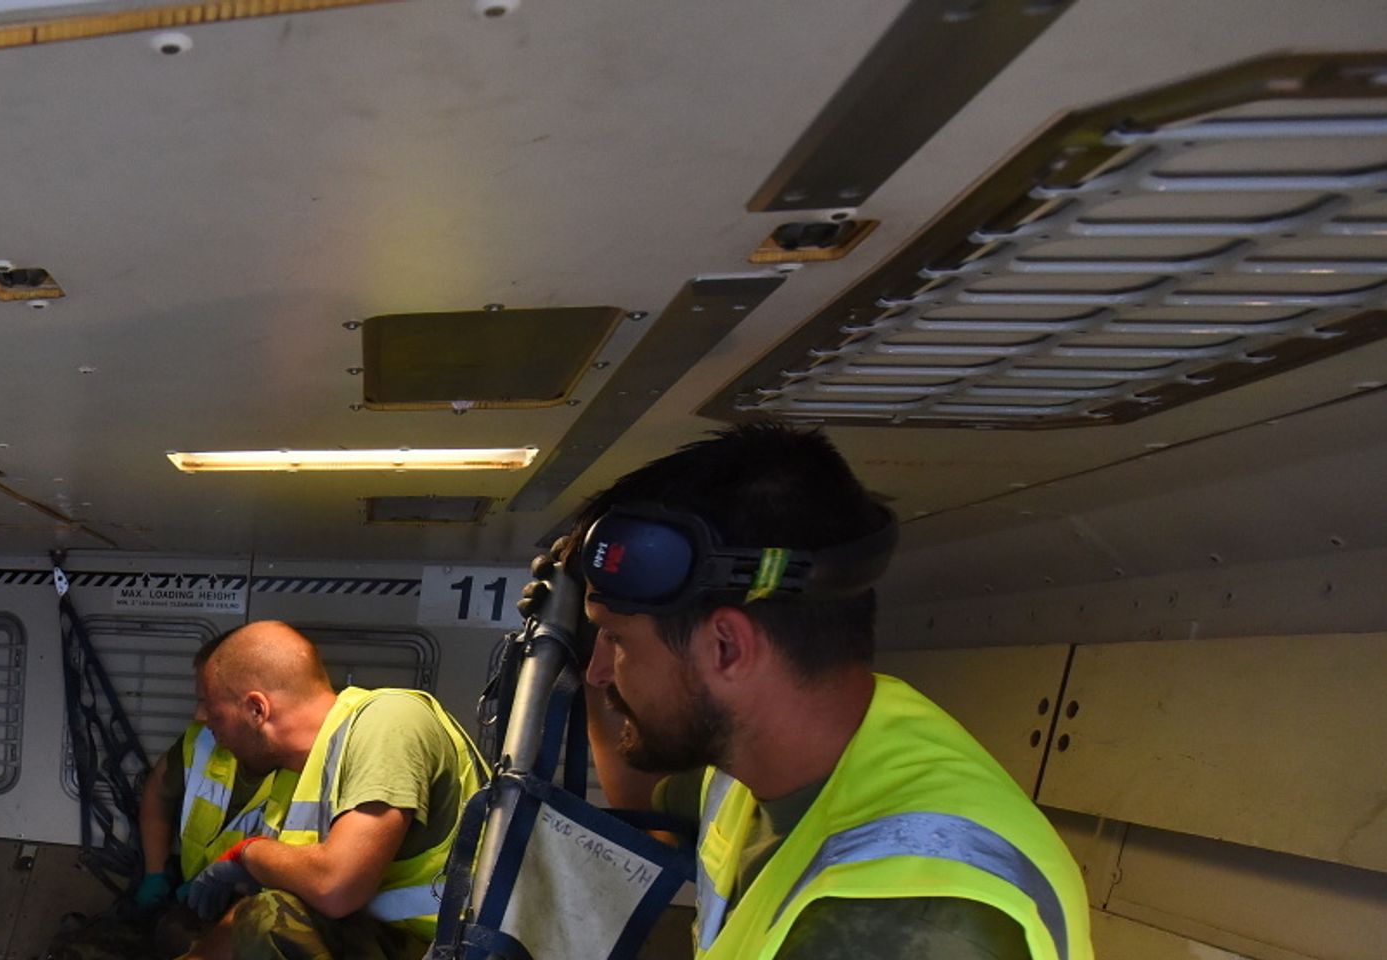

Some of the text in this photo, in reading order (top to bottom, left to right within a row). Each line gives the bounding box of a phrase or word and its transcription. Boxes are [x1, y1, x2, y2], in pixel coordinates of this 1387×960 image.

[149, 590, 194, 599] LOADING
[198, 591, 237, 601] HEIGHT
[450, 575, 508, 621] 11
